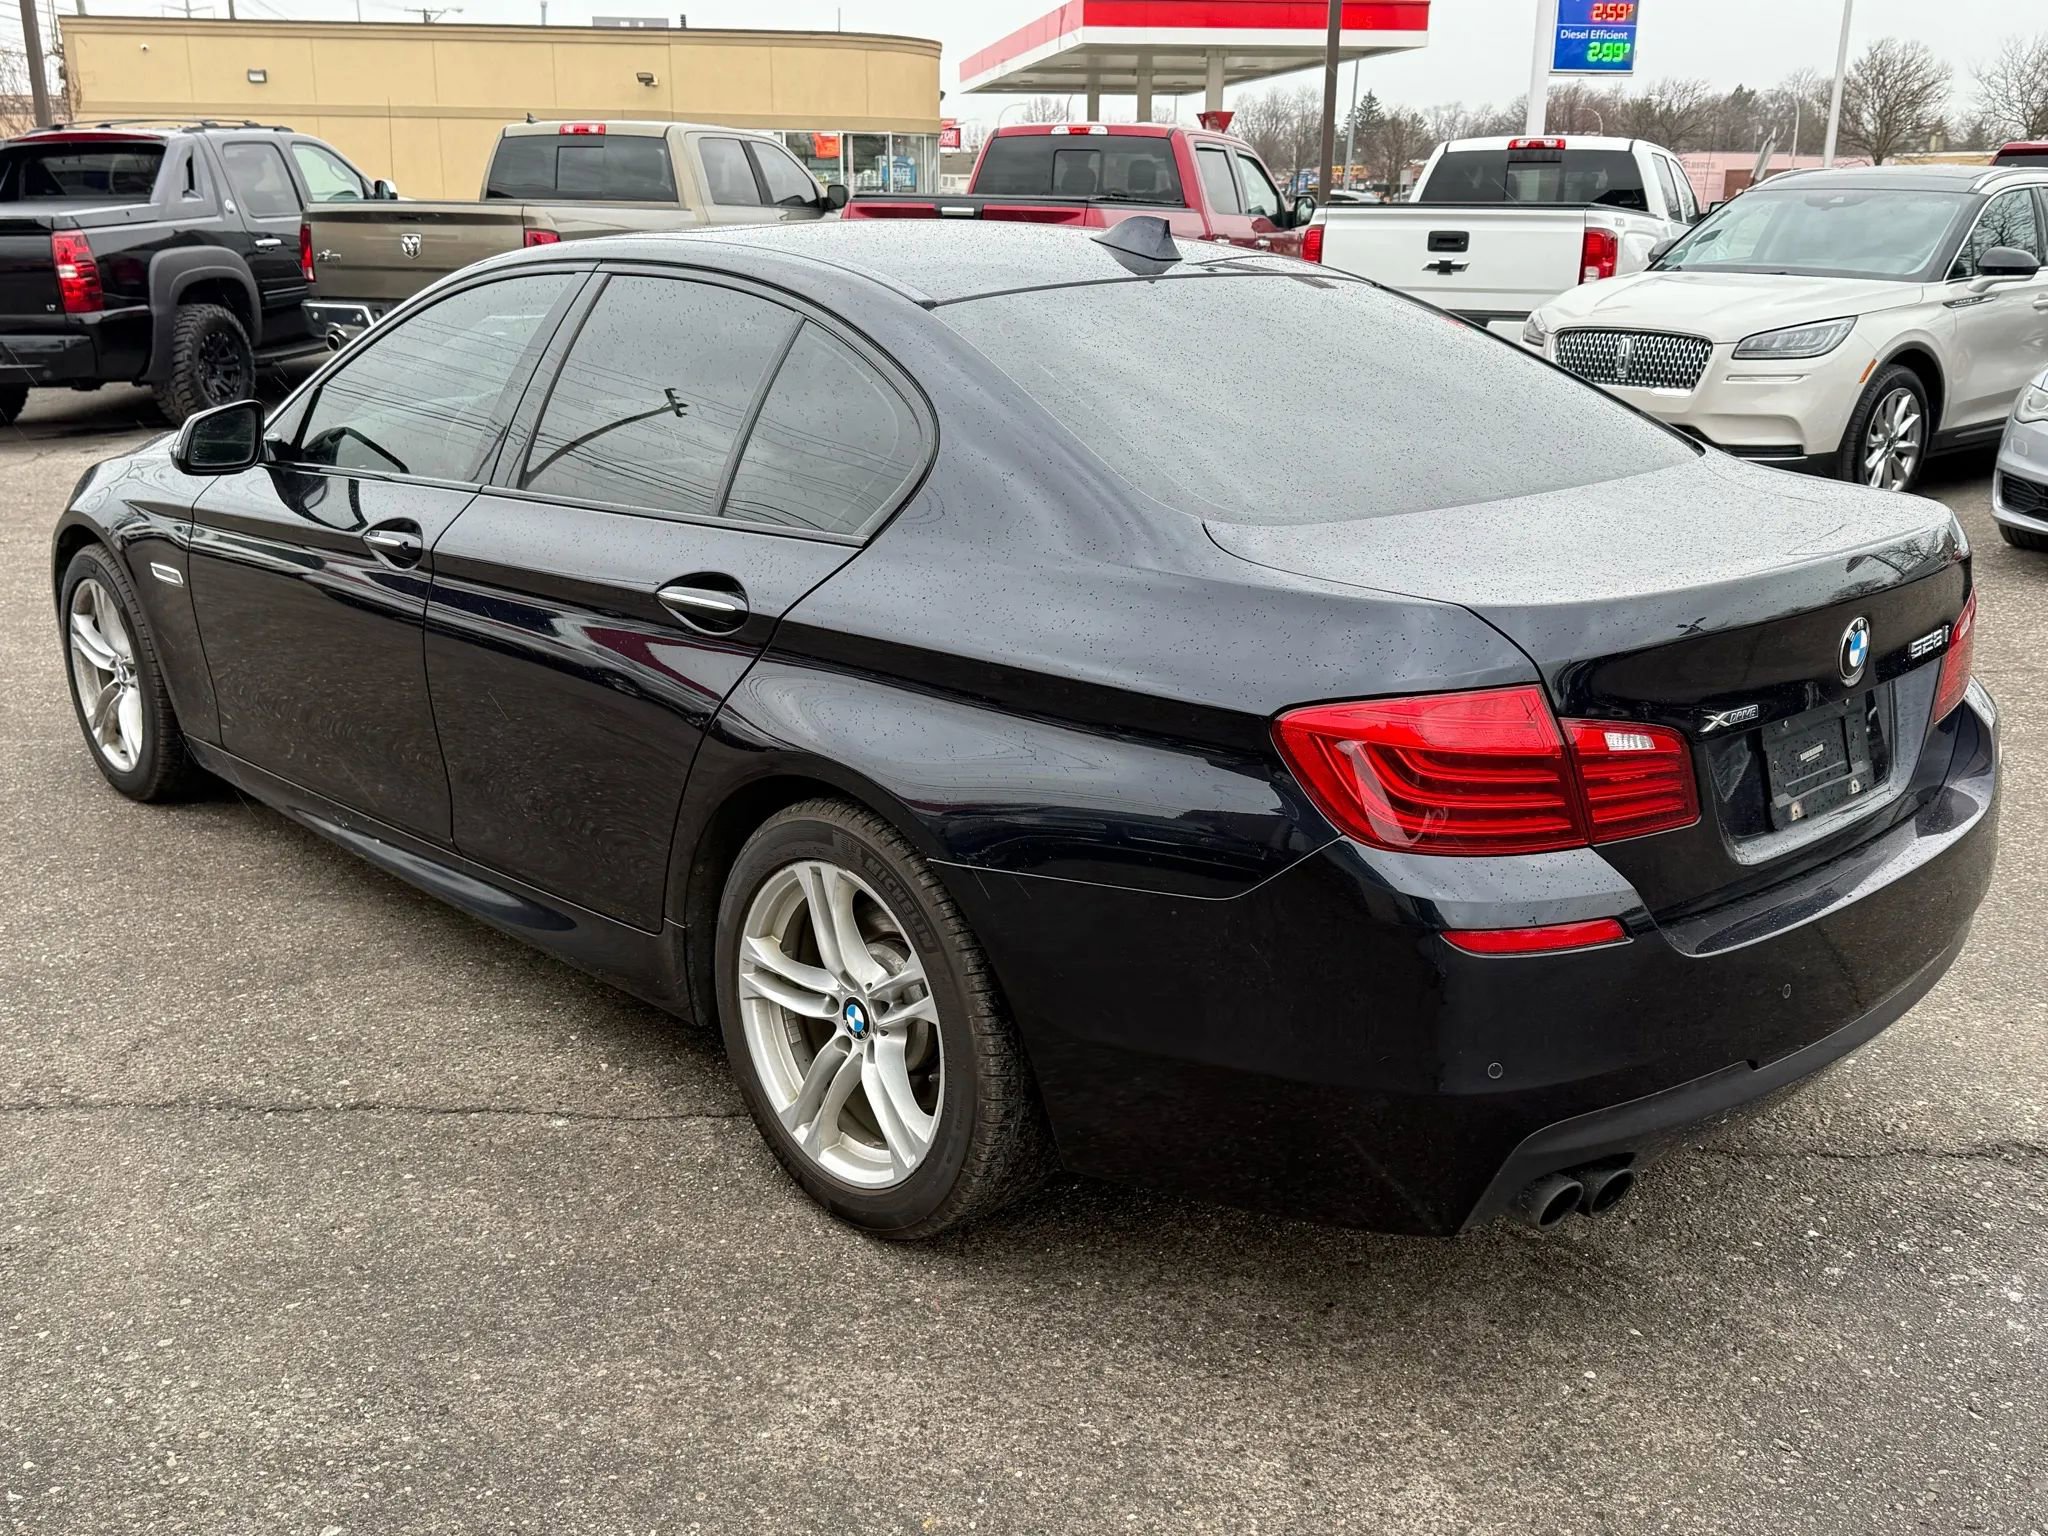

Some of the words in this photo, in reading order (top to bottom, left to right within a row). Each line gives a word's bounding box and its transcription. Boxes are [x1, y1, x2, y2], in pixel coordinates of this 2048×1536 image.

[1560, 29, 1588, 39] Diesel
[1590, 29, 1628, 39] Efficient
[1909, 625, 1949, 659] 528i
[864, 857, 937, 949] MICHELIN
